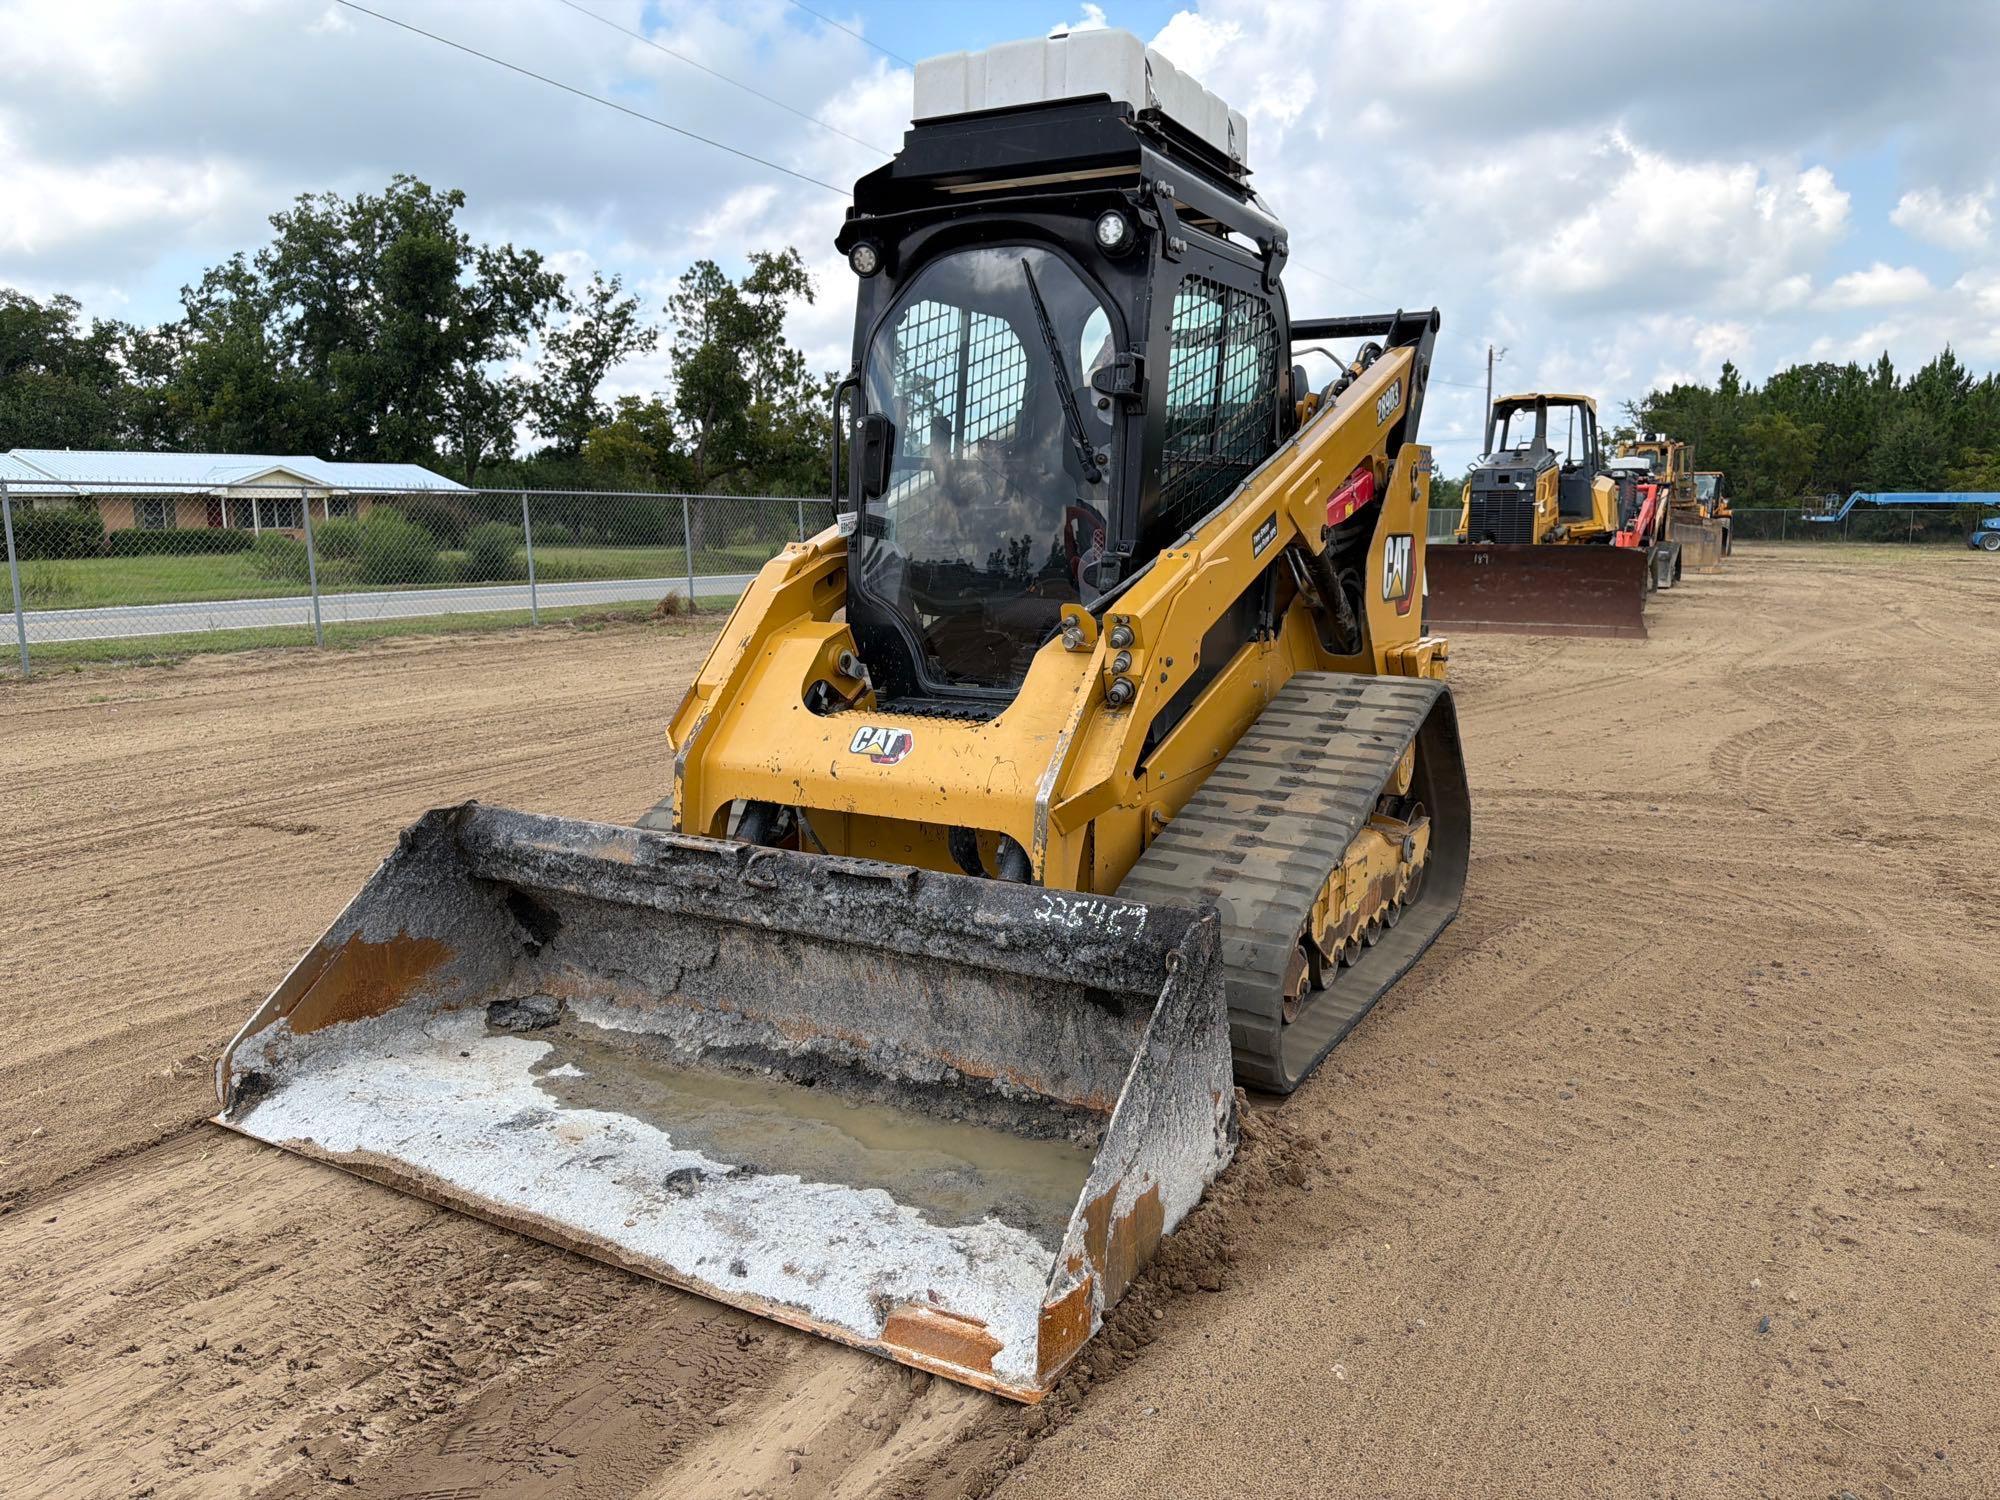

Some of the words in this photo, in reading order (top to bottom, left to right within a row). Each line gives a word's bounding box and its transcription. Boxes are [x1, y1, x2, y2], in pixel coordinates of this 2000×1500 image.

[1377, 380, 1400, 426] 289D3
[1383, 536, 1411, 599] CAT
[850, 726, 903, 756] CAT
